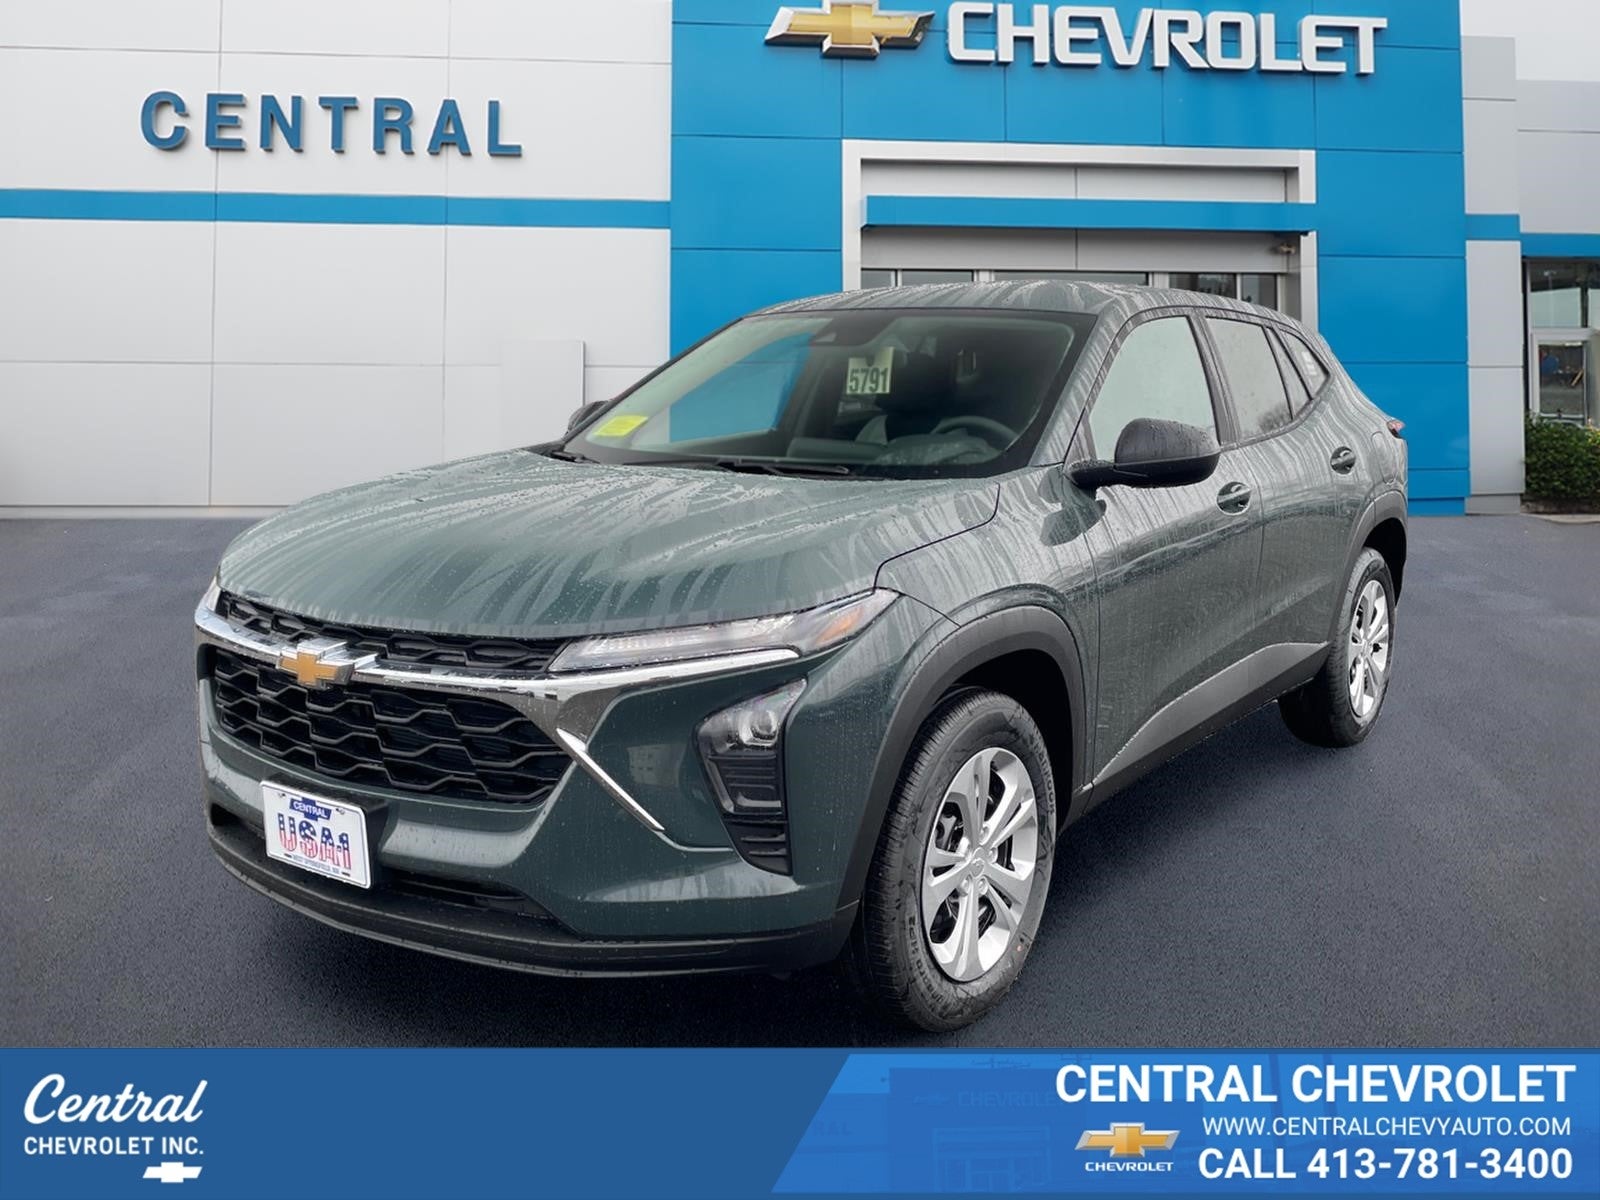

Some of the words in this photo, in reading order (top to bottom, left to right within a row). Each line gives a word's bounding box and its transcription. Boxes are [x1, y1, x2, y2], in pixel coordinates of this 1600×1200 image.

[947, 1, 1388, 76] CHEVROLET
[140, 90, 523, 158] CENTRAL
[849, 367, 889, 392] 5791
[292, 800, 329, 818] CENTRAL
